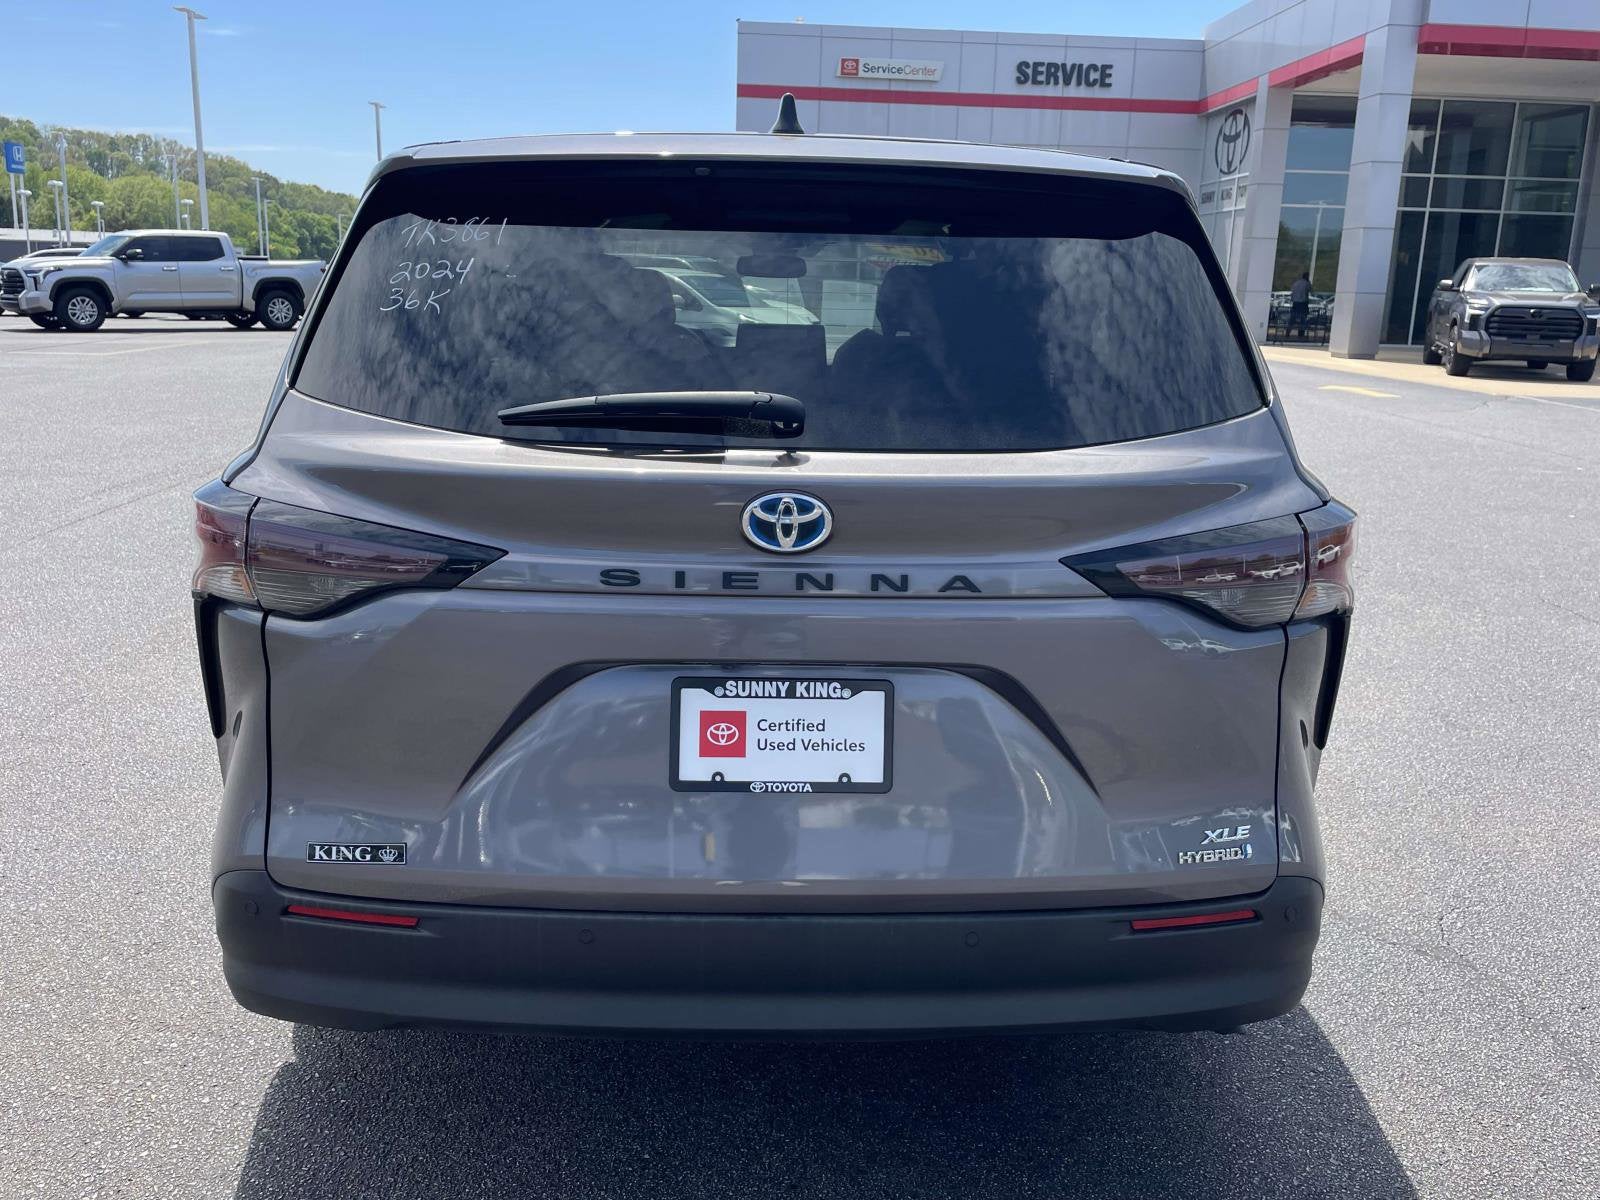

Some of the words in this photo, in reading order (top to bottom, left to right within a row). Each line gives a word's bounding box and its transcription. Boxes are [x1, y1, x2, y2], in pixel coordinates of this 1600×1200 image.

[862, 62, 938, 77] ServiceCenter
[1016, 61, 1113, 88] SERVICE
[401, 216, 507, 248] TK3861
[389, 257, 474, 285] 2024
[379, 287, 450, 315] 36K
[599, 568, 983, 594] SIENNA
[724, 680, 790, 697] SUNNY
[795, 682, 843, 698] KING
[756, 718, 826, 732] Certified
[756, 738, 796, 752] Used
[801, 738, 866, 752] Vehicles
[766, 782, 813, 793] TOYOTA
[1200, 825, 1251, 844] XLE
[313, 845, 372, 861] KING
[1179, 847, 1242, 864] HYBRID
